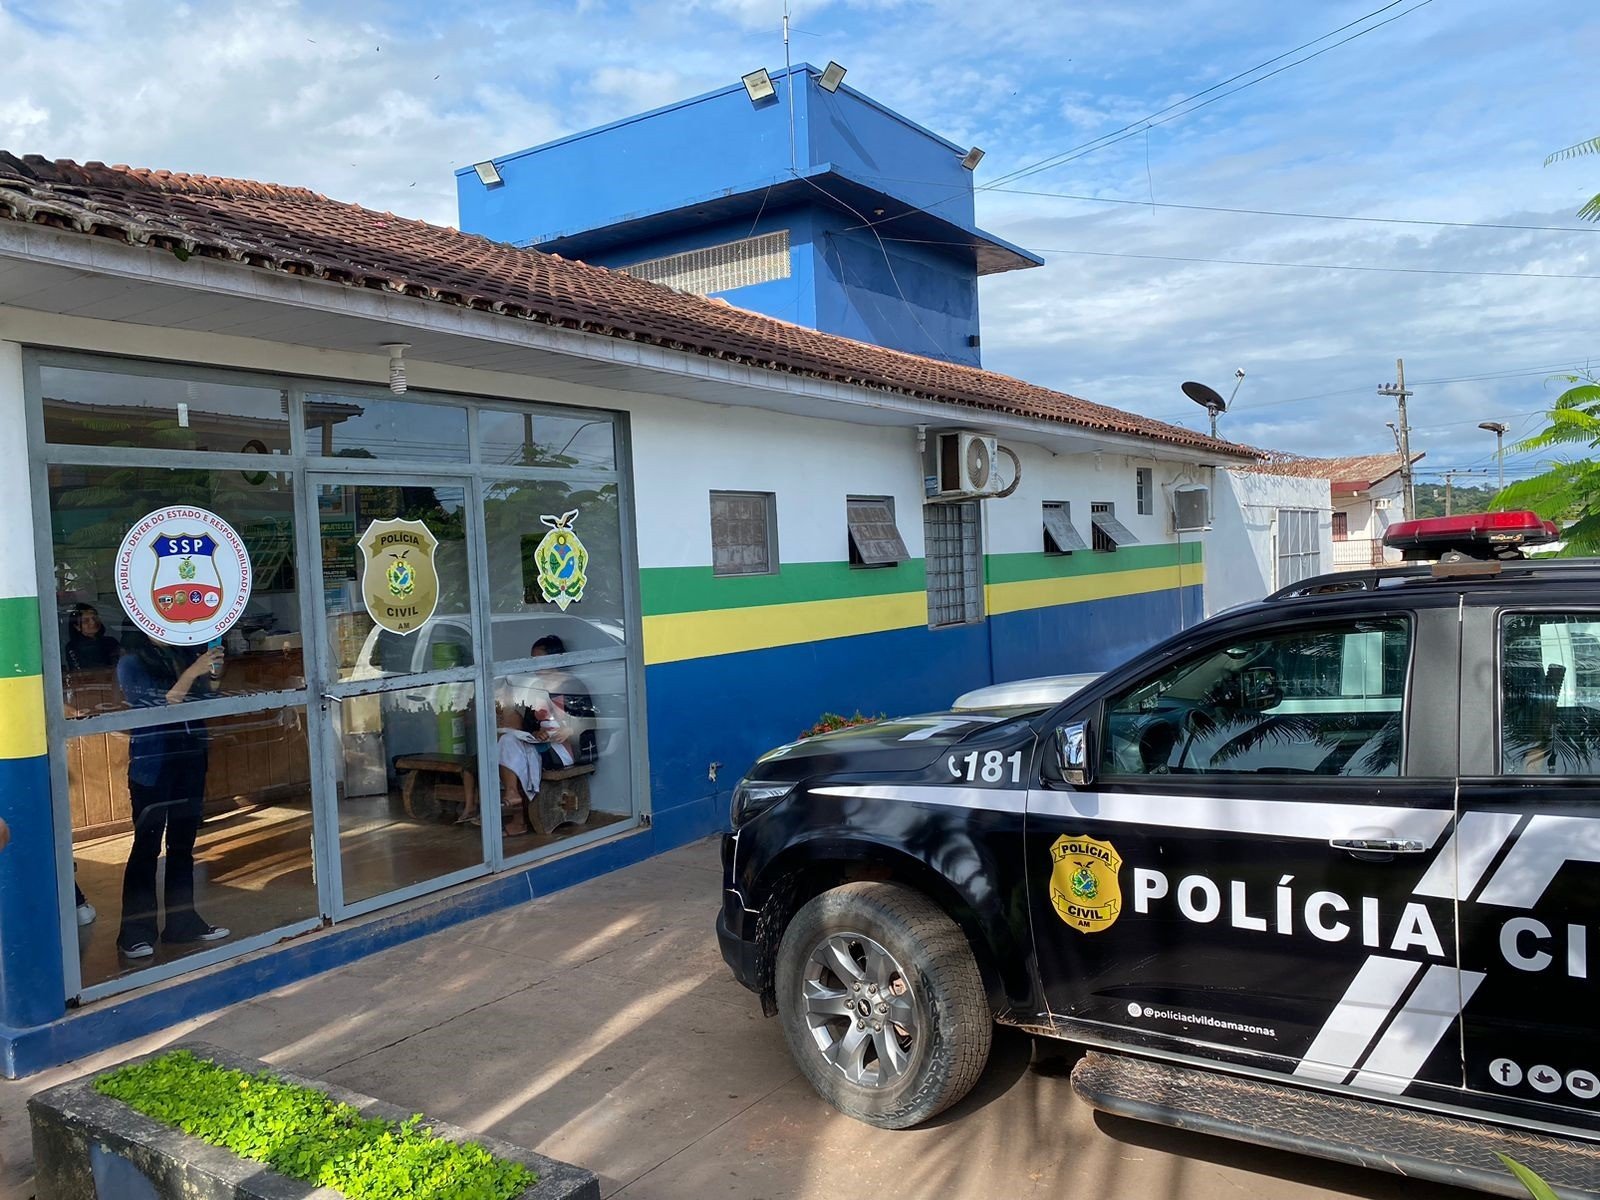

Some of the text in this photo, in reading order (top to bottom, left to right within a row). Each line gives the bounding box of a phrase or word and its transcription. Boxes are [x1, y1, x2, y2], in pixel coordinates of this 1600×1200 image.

[151, 513, 165, 525] DO
[167, 509, 201, 519] ESTADO
[128, 522, 152, 547] DEVER
[380, 531, 420, 546] POLÍCIA
[168, 539, 203, 554] SSP
[209, 517, 248, 593] RESPONSABILIDADE
[235, 595, 245, 607] DE
[386, 606, 419, 617] CIVIL
[214, 608, 239, 632] TODOS
[398, 622, 410, 630] AM
[963, 750, 1022, 783] 181
[1061, 842, 1110, 862] POLÍCIA
[1067, 905, 1103, 919] CIVIL
[1134, 867, 1445, 957] POLÍCIA
[1078, 920, 1091, 928] AM
